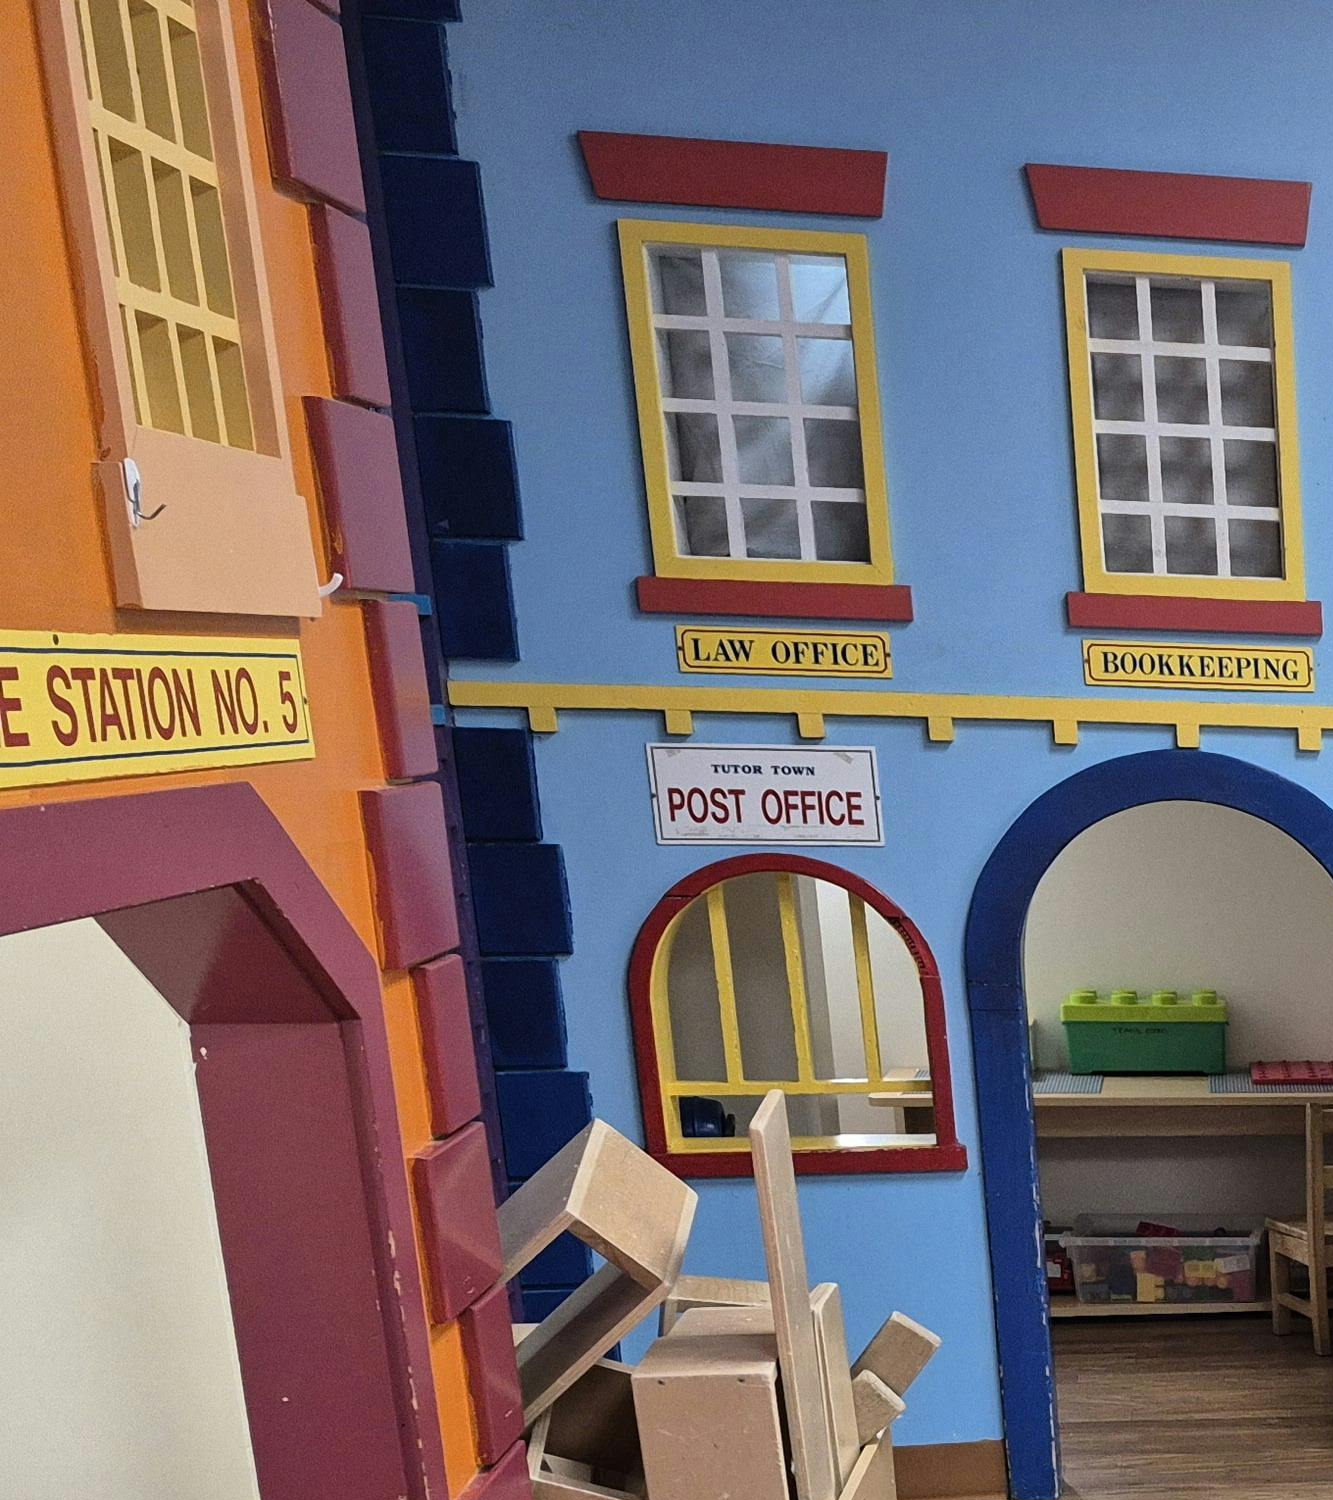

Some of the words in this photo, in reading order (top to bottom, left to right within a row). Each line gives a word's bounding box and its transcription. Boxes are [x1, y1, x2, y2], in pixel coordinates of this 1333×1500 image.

[690, 637, 755, 663] LAW
[770, 640, 880, 667] OFFICE
[1101, 650, 1299, 681] BOOKKEEPING
[46, 664, 202, 747] STATION
[210, 666, 270, 736] NO.
[277, 670, 298, 734] 5
[711, 763, 763, 775] TUTOR
[772, 765, 816, 776] TOWN
[667, 786, 746, 824] POST
[761, 788, 865, 826] OFFICE
